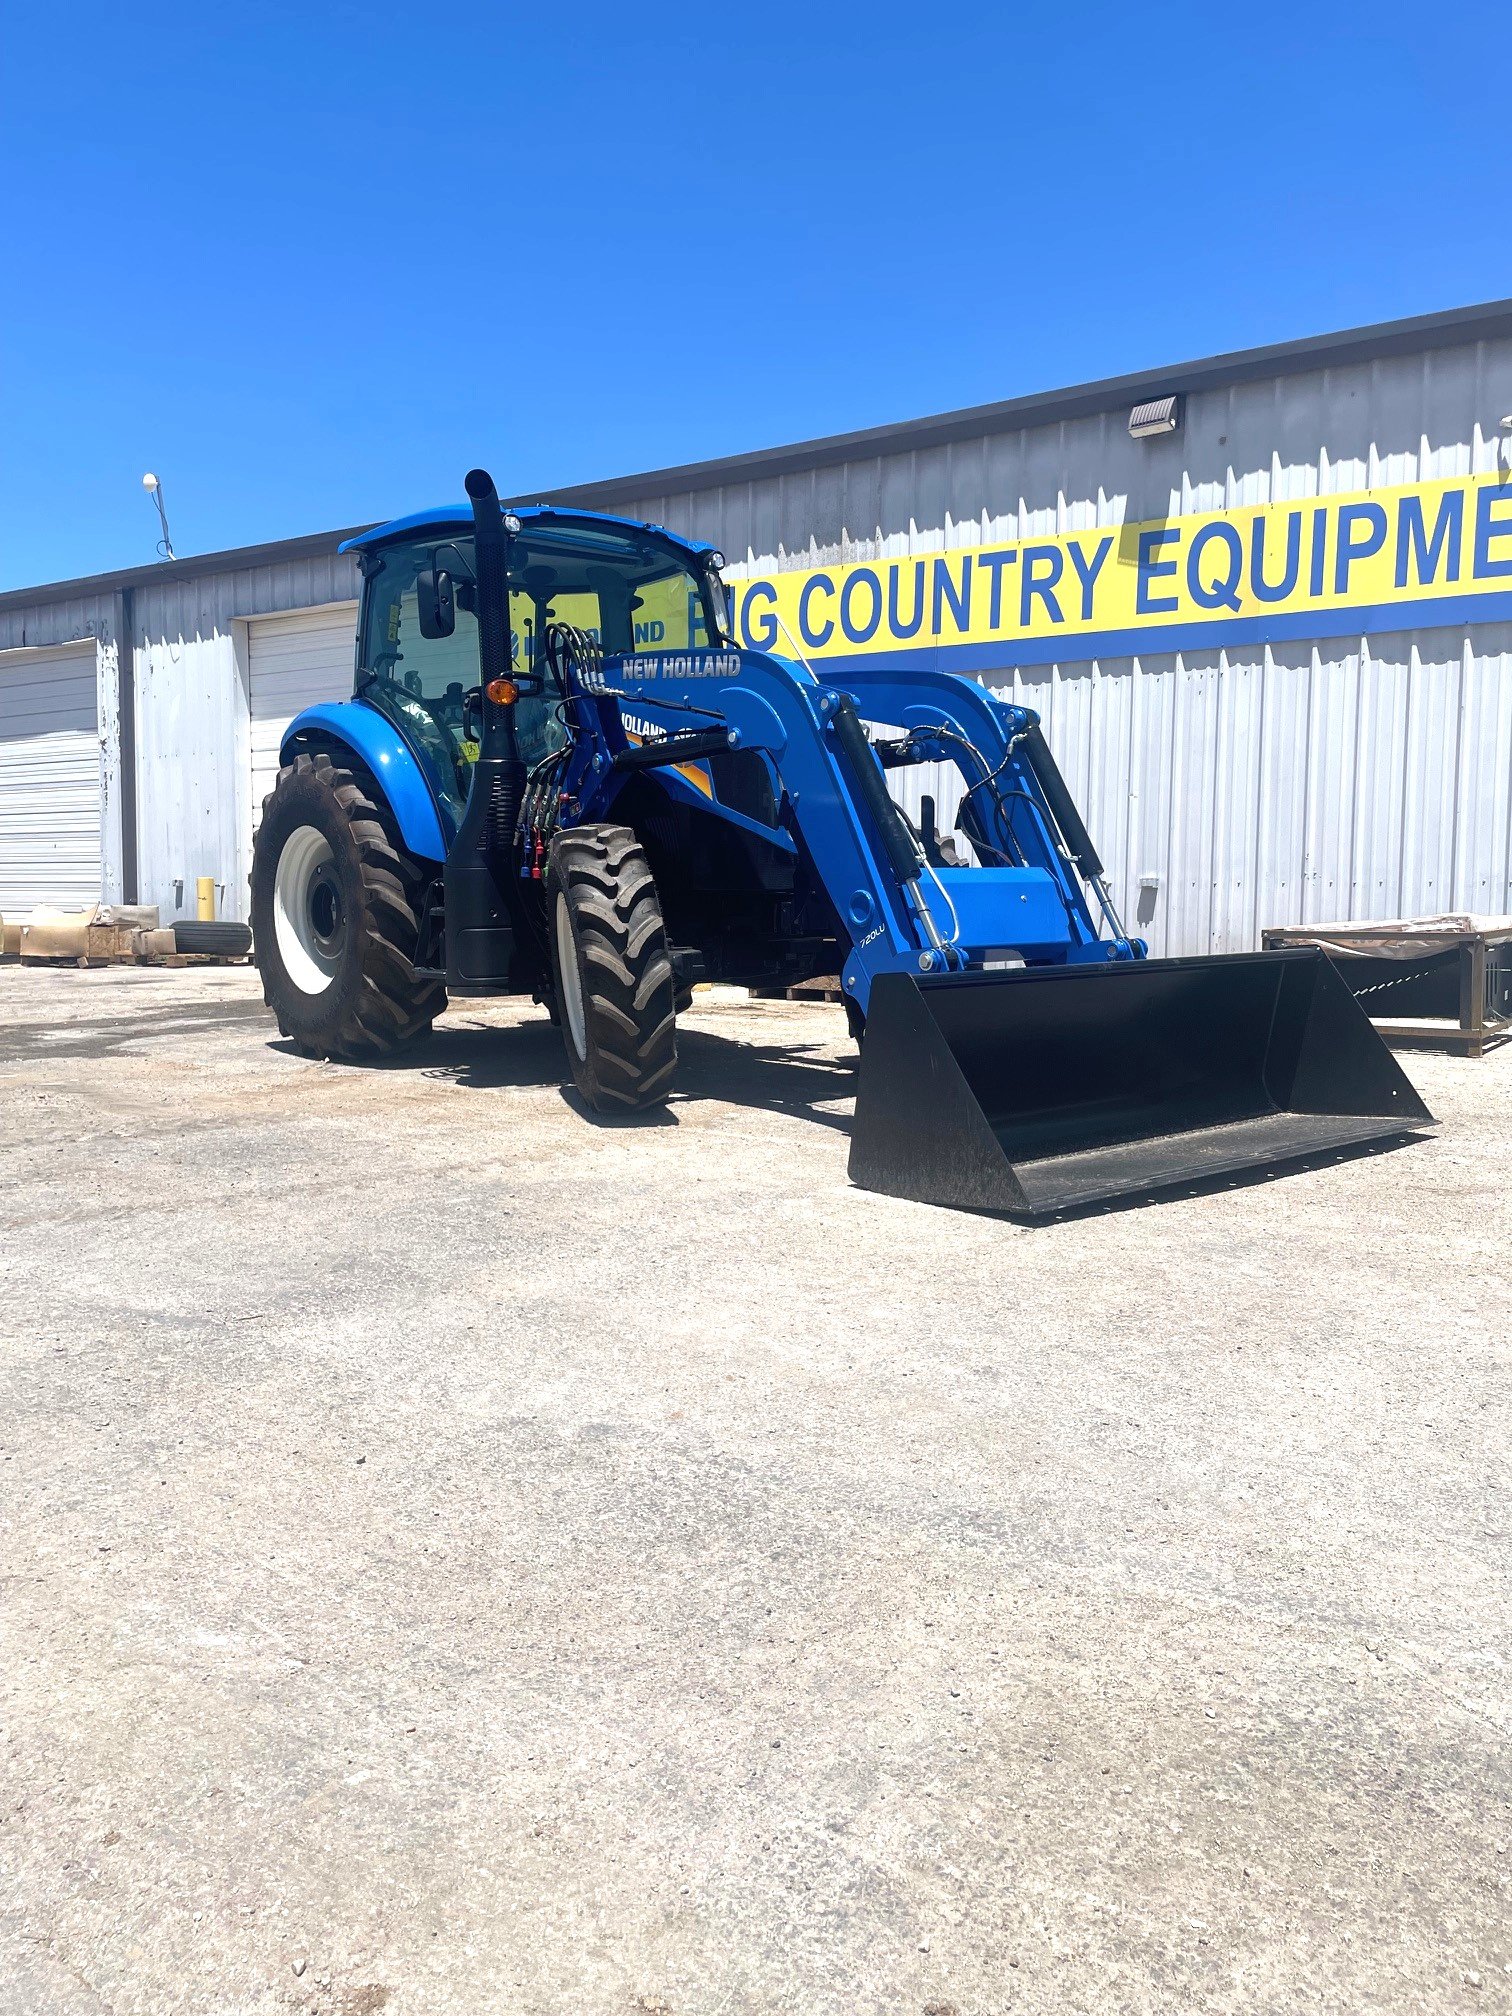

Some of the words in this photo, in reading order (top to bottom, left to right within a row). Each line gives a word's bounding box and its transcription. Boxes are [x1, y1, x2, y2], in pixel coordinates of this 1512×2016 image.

[799, 537, 1114, 648] COUNTRY
[1136, 484, 1512, 615] EQUIPME
[622, 658, 658, 680] NEW
[662, 654, 740, 679] HOLLAND
[860, 923, 885, 948] 720LU
